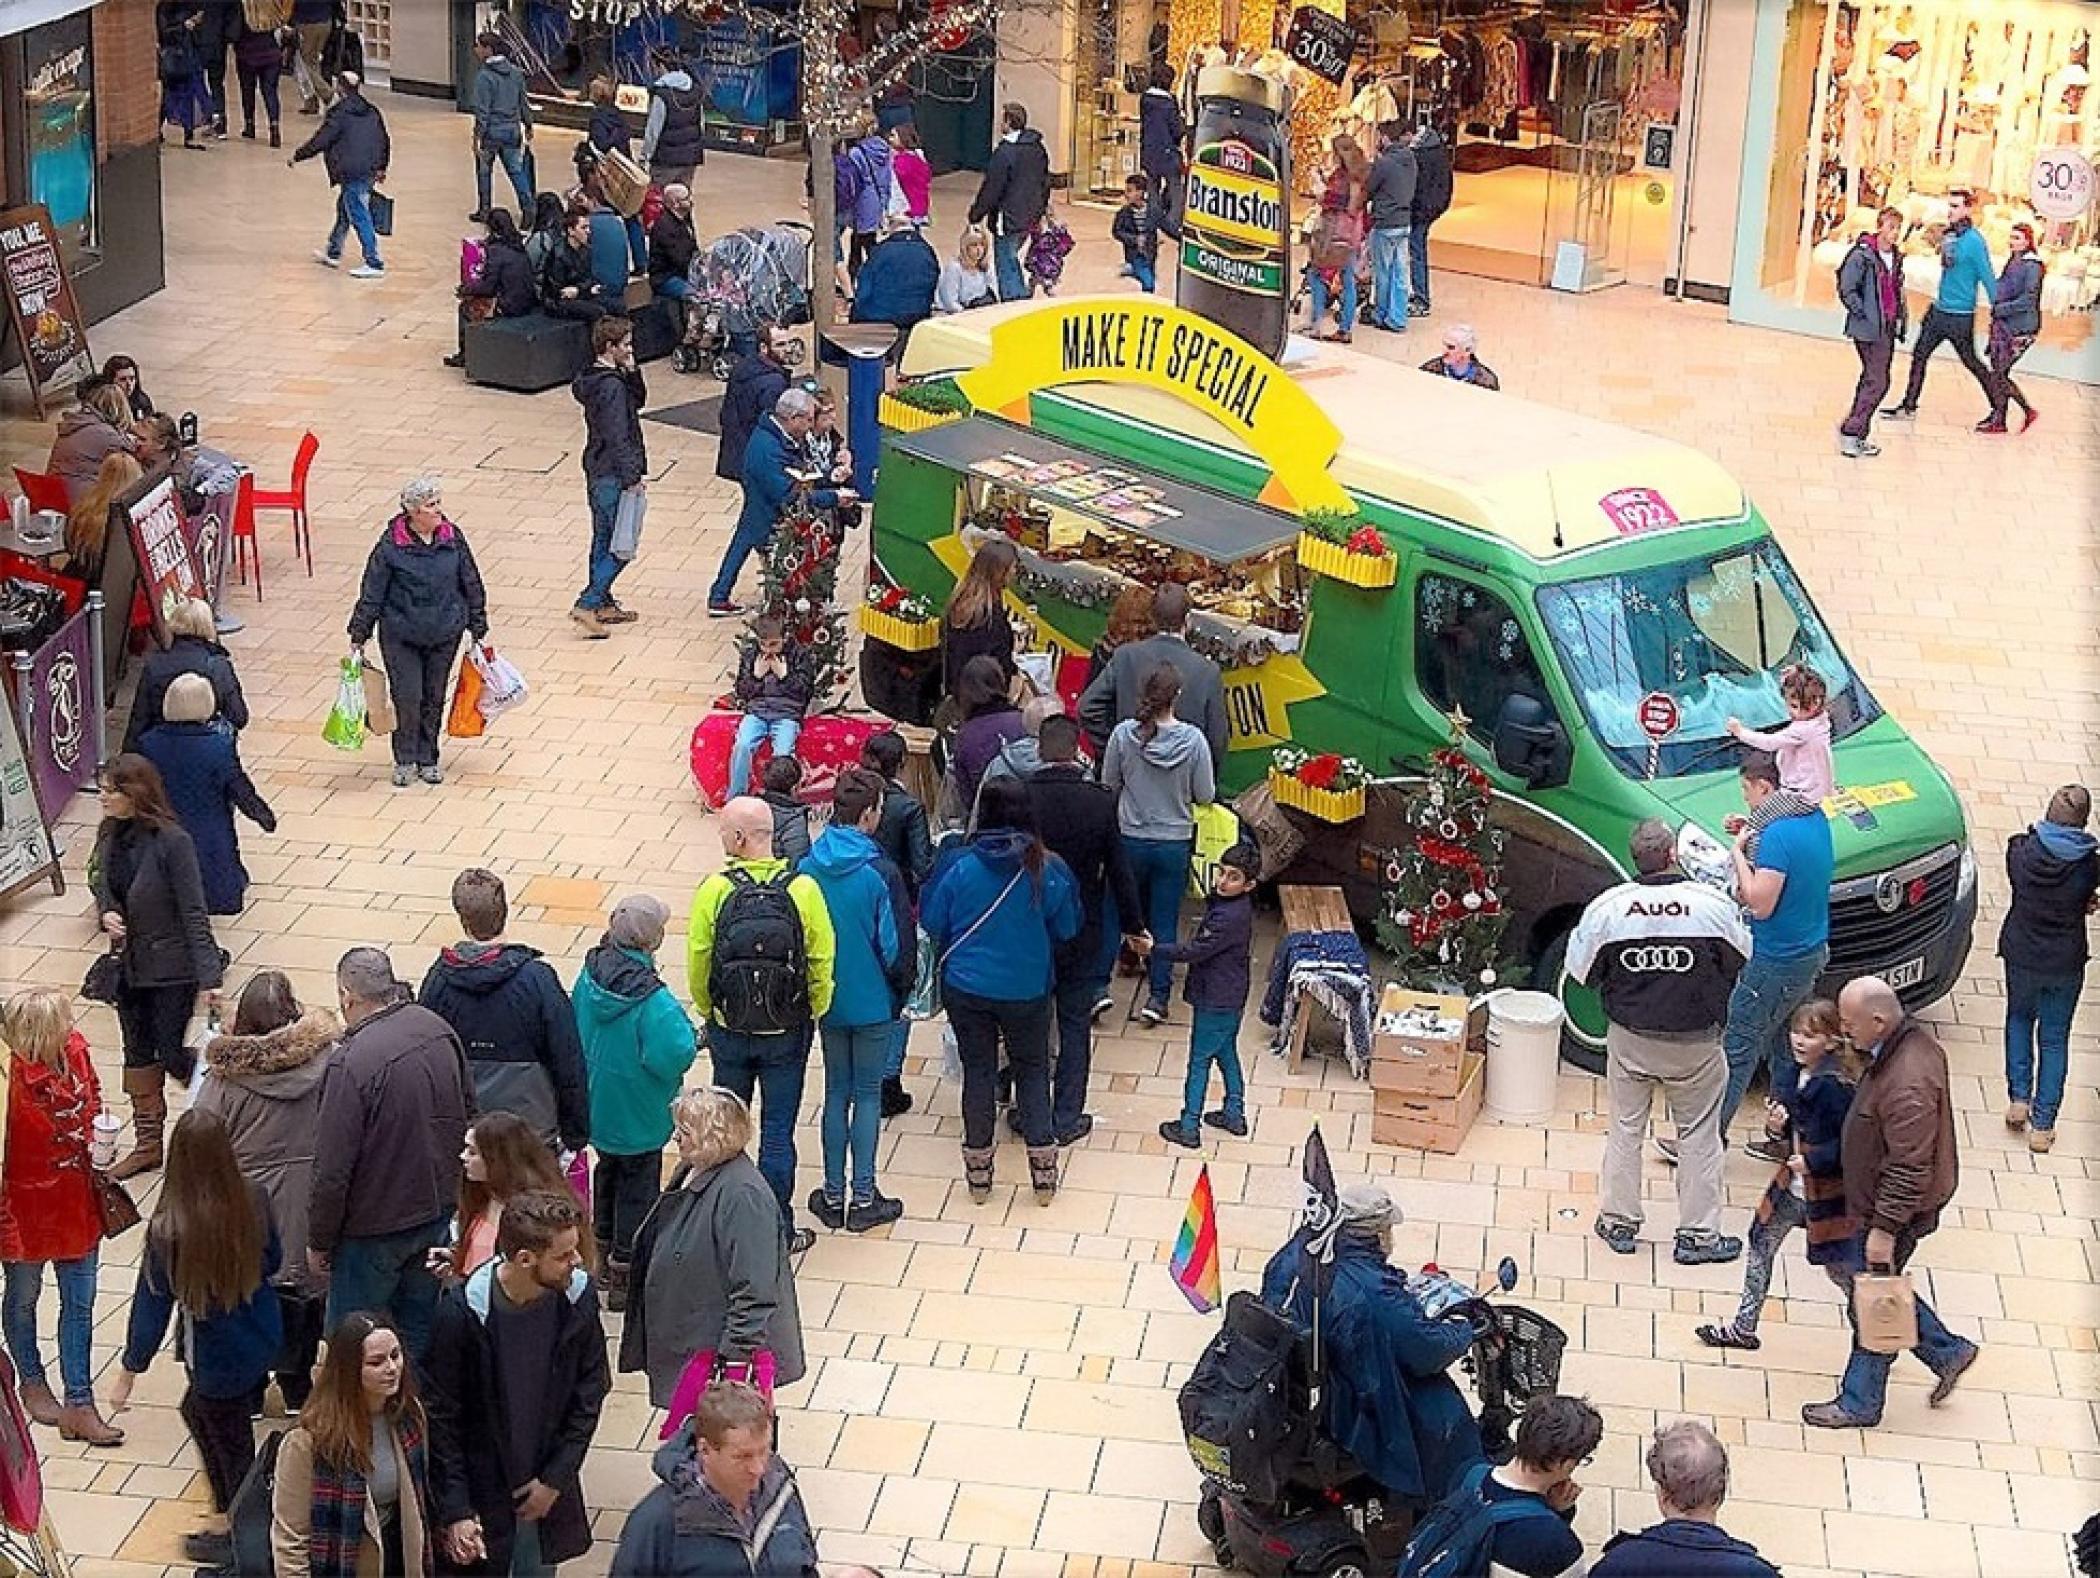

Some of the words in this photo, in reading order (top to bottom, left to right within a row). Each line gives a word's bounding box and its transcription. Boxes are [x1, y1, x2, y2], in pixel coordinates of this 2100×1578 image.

[1189, 174, 1281, 232] Branston
[1199, 250, 1265, 284] ORIGINAL
[1062, 312, 1130, 372] MAKE
[1135, 314, 1164, 372] IT
[1166, 323, 1269, 429] SPECIAL
[1616, 503, 1674, 535] 1922
[1624, 901, 1690, 918] Audi
